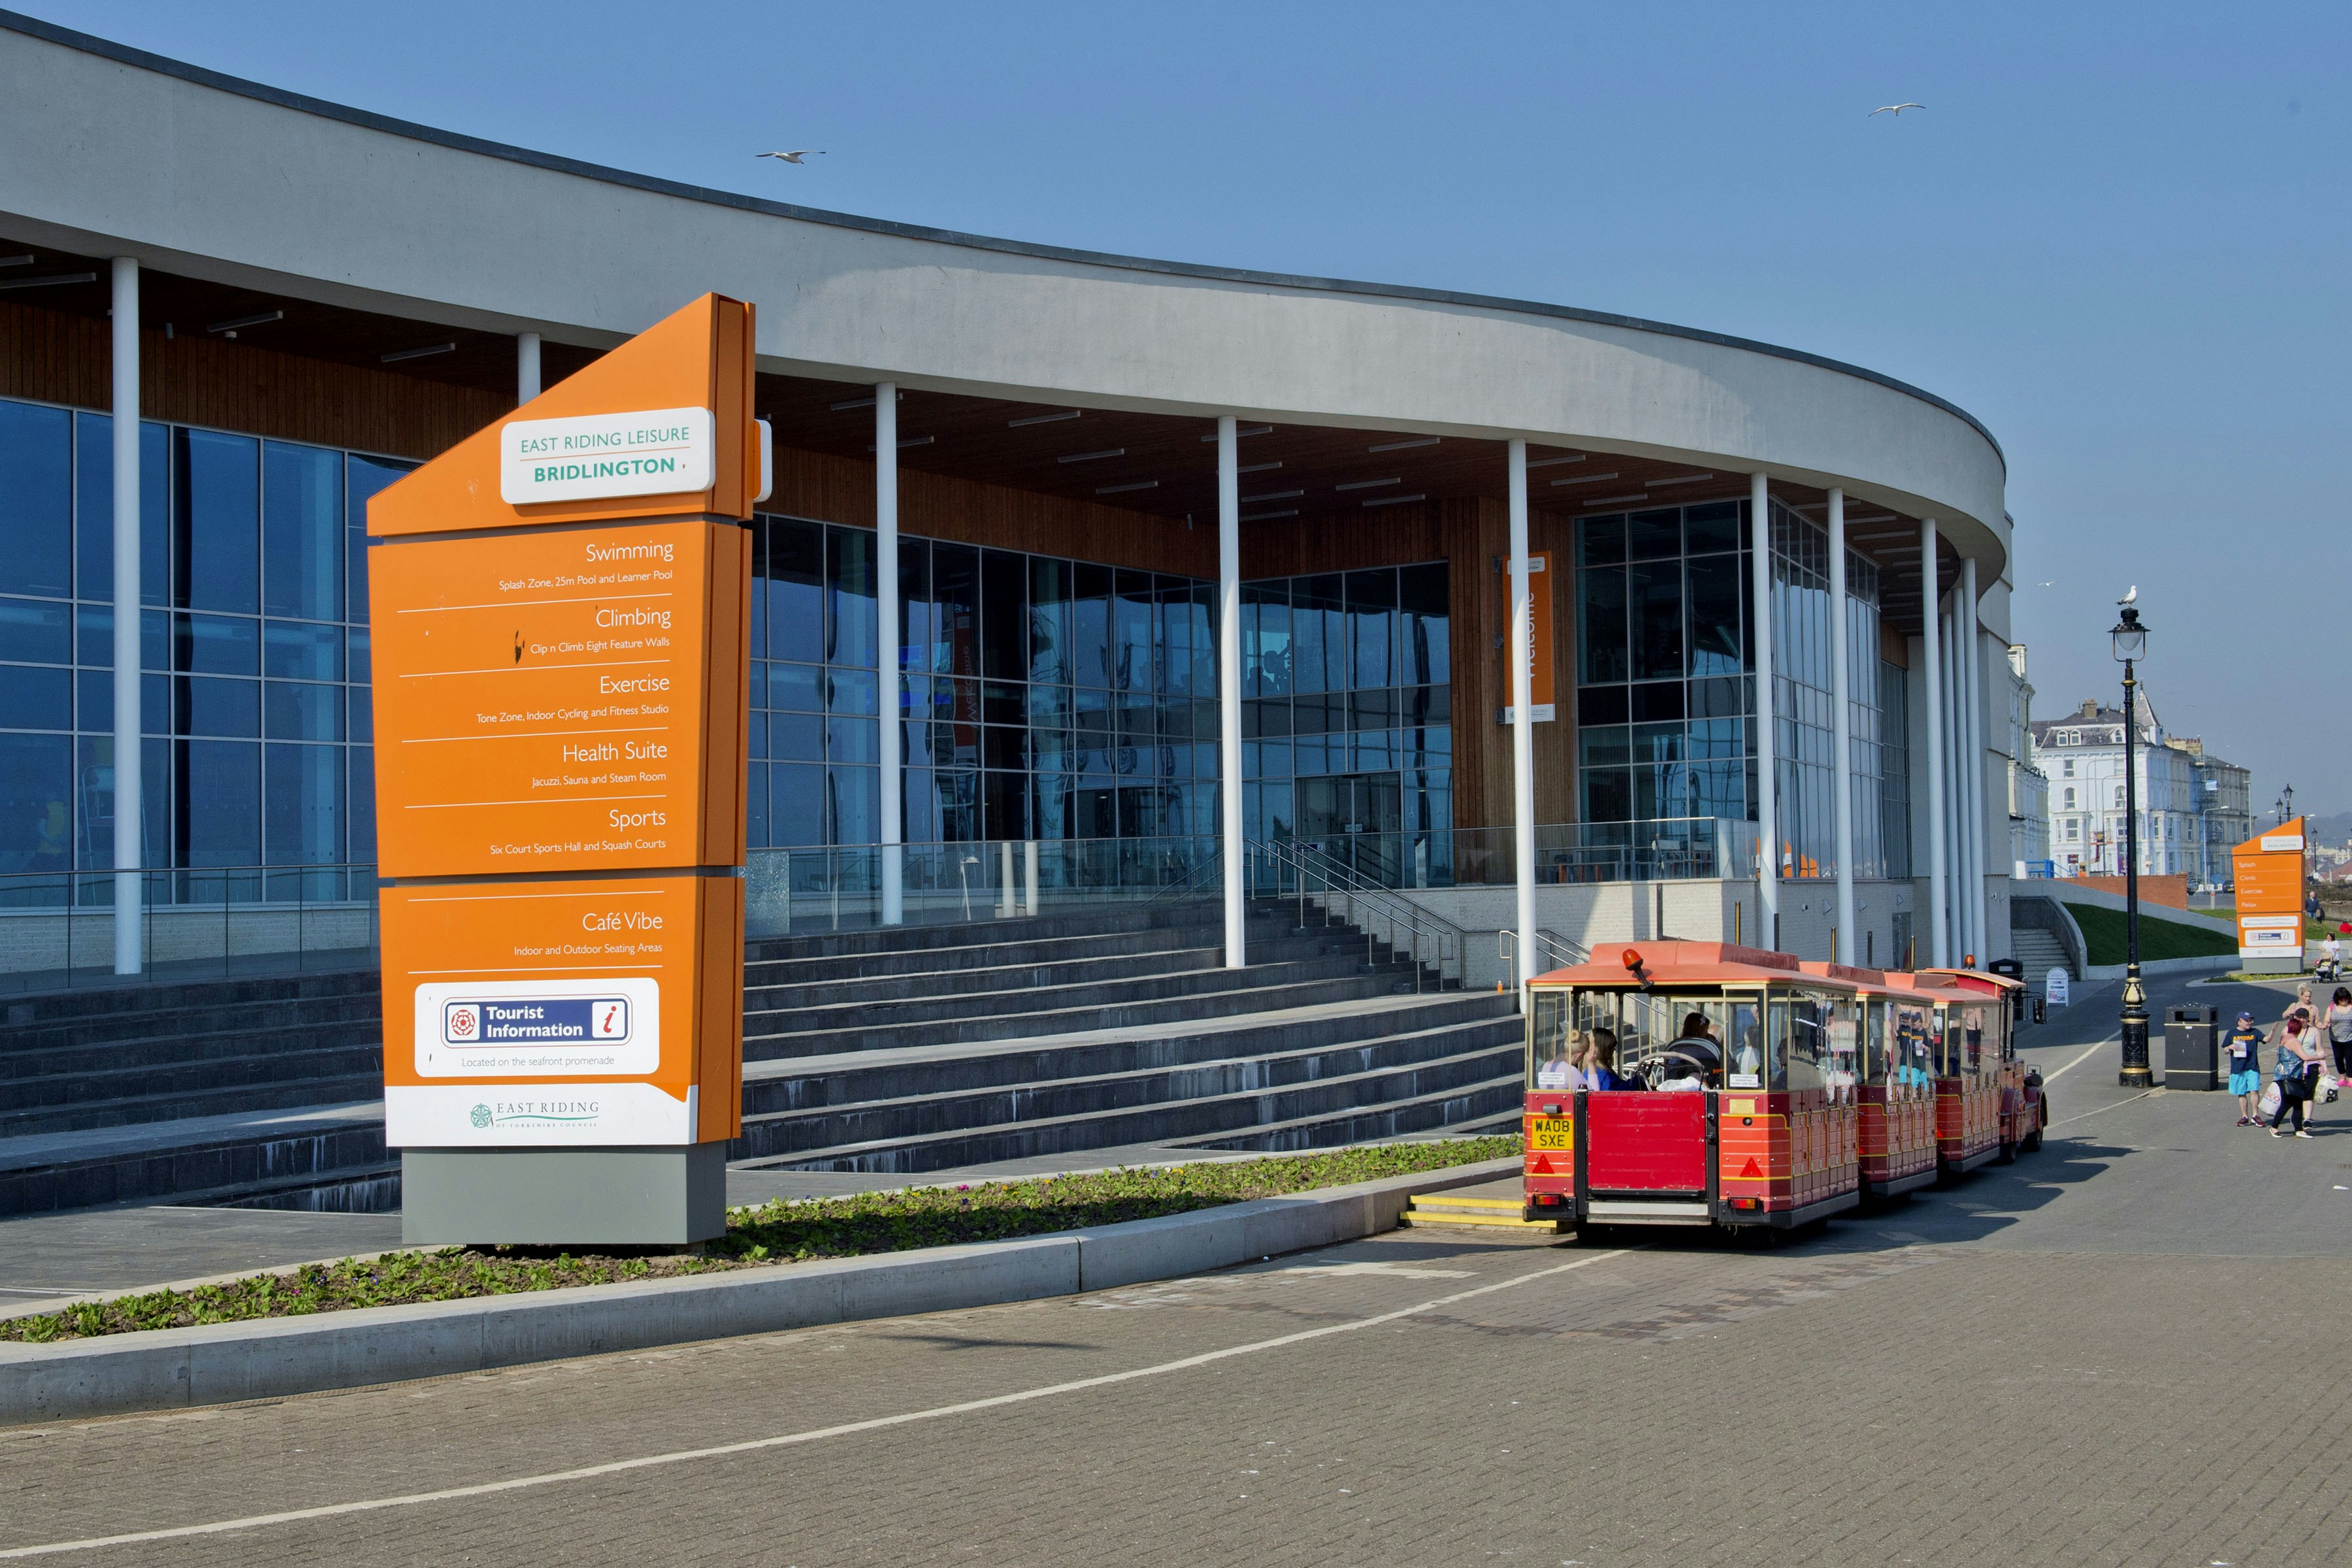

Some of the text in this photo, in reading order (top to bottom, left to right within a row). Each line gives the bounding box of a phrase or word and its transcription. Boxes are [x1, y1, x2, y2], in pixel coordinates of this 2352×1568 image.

[521, 427, 689, 453] EAST RIDING LEISURE
[534, 458, 674, 482] BRIDLINGTON
[587, 541, 673, 562] Swimming
[500, 570, 672, 591] Splash Zone, 25m Pool and Learner Pool
[596, 608, 671, 629] Climbing
[531, 644, 547, 655] Clip
[559, 642, 583, 652] Climb
[587, 642, 607, 652] Eight
[611, 640, 642, 648] Feature
[645, 638, 669, 646] Walls
[601, 674, 669, 693] Exercise
[476, 704, 669, 723] Tone Zone, Indoor Cycling and Fitness Studio
[564, 742, 667, 762] Health Suite
[532, 772, 666, 788] Jacuzzi, Sauna and Steam Room
[610, 809, 666, 832] Sports
[491, 840, 666, 854] Six Court Sports Hall and Squash Courts
[583, 912, 662, 930] Café Vibe
[515, 943, 662, 955] Indoor and Outdoor Seating Areas
[486, 1006, 544, 1019] Tourist
[487, 1023, 582, 1037] Information
[463, 1058, 495, 1066] Located
[529, 1056, 562, 1066] seafront
[566, 1056, 614, 1067] promenade
[497, 1102, 599, 1113] EAST RIDING
[1535, 1120, 1569, 1132] WA08
[1540, 1135, 1565, 1146] SXE
